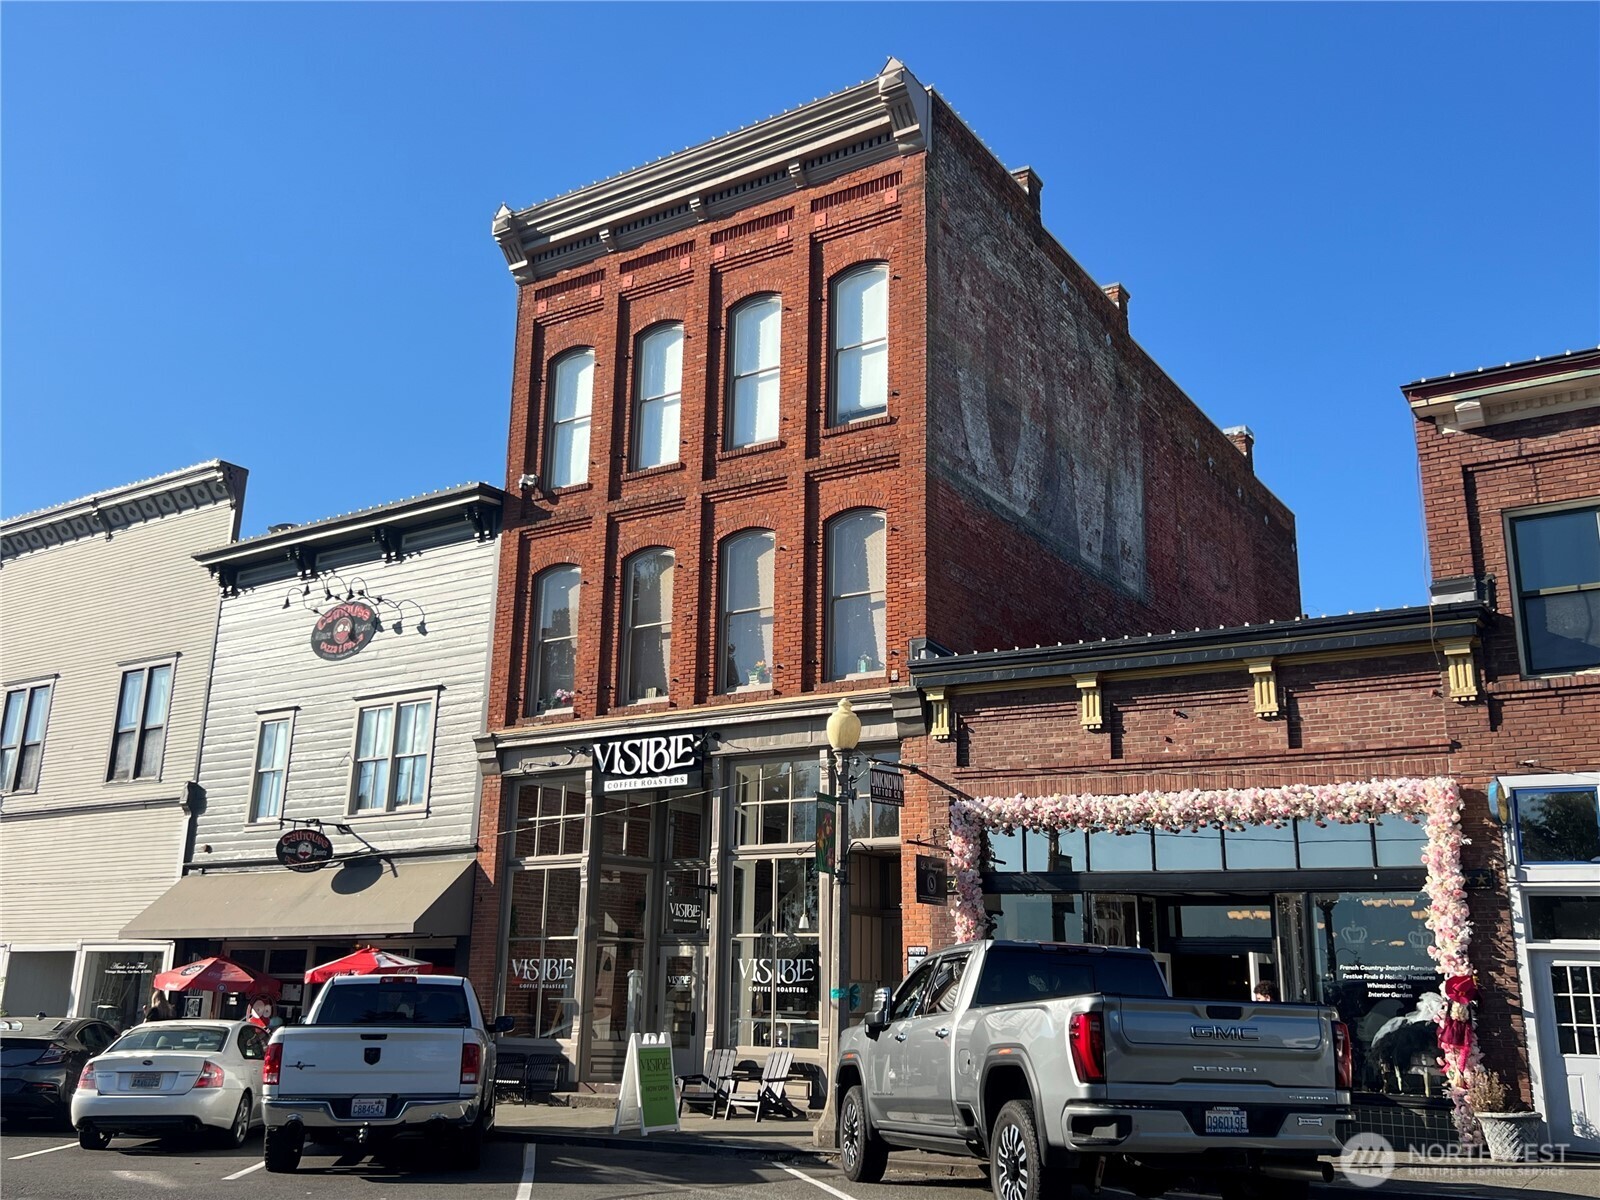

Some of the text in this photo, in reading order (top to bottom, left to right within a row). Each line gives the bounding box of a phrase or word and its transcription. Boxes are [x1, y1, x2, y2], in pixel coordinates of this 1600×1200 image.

[593, 734, 695, 775] VISIBLE
[607, 776, 685, 790] COFFEE ROASTERS
[870, 771, 904, 791] UNKNOWN
[872, 786, 892, 797] TATTOO
[669, 903, 701, 917] VISIBLE
[512, 958, 574, 981] VISIBLE
[737, 958, 814, 984] VISIBLE
[1360, 964, 1410, 972] Country-Inspired
[1190, 1025, 1260, 1041] GMC
[640, 1057, 672, 1072] VISIBLE
[1193, 1065, 1257, 1073] DENALI
